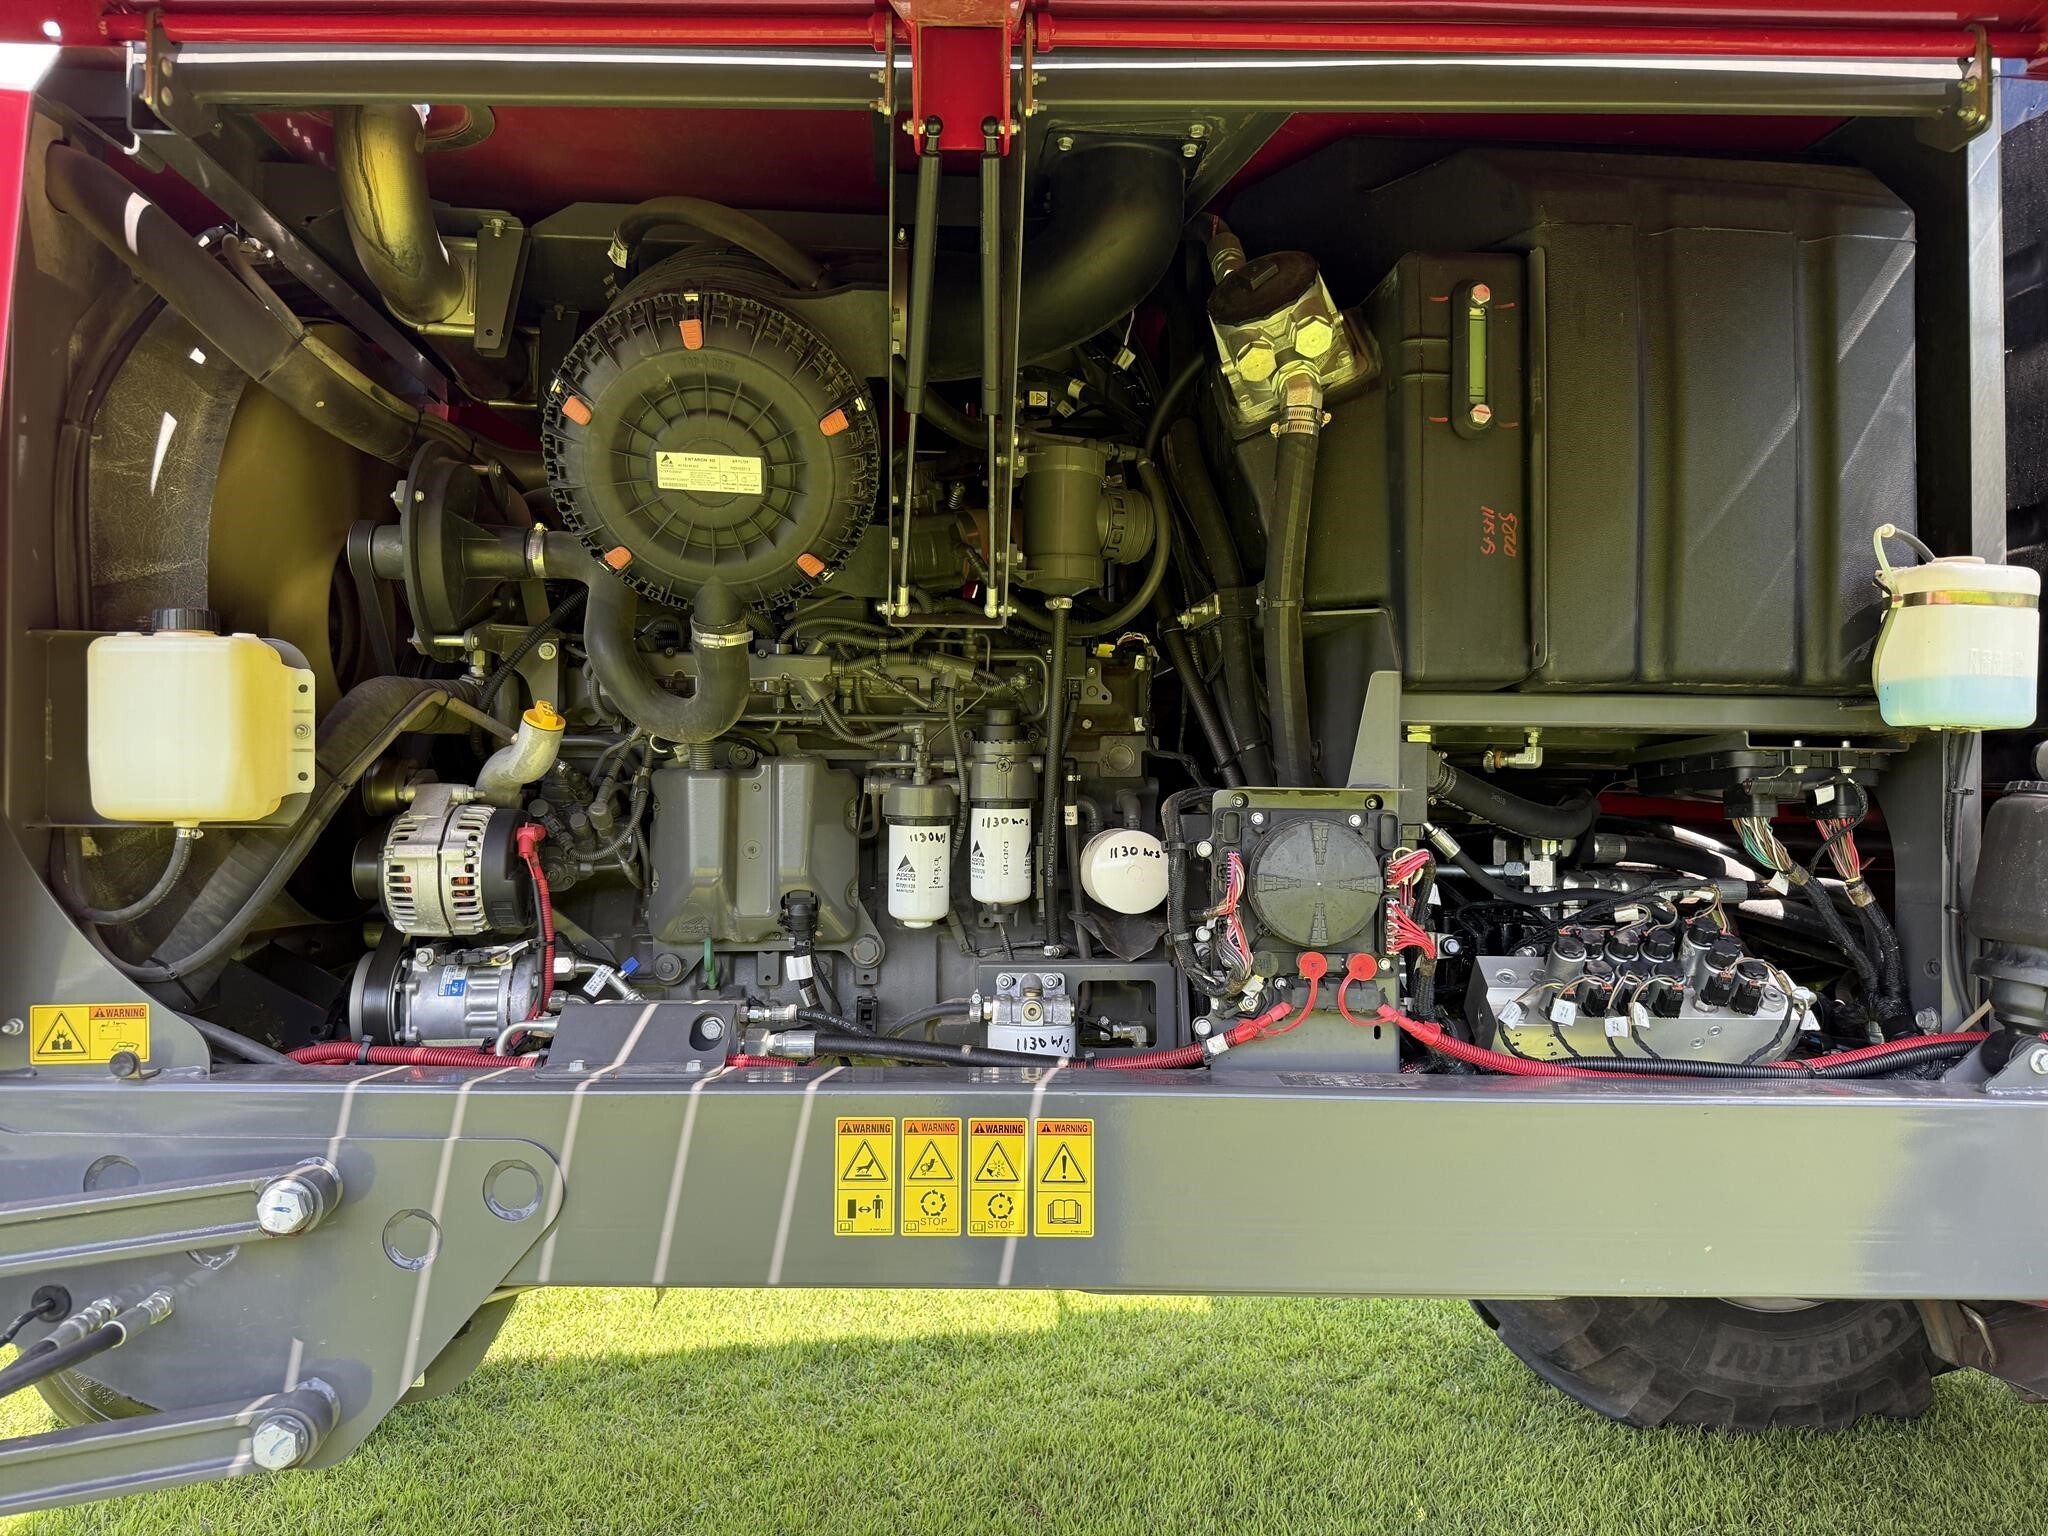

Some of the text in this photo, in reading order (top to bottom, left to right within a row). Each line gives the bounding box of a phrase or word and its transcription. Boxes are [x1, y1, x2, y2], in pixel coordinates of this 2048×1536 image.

[1110, 846, 1161, 859] 1130 hrs
[105, 1007, 145, 1018] WARNING
[1016, 1037, 1047, 1051] 1130
[852, 1122, 891, 1133] WARNING
[921, 1122, 956, 1133] WARNING
[985, 1123, 1024, 1134] WARNING
[1054, 1123, 1088, 1133] WARNING
[920, 1217, 948, 1226] STOP
[987, 1220, 1015, 1229] STOP
[1715, 1306, 1903, 1375] CHELIN
